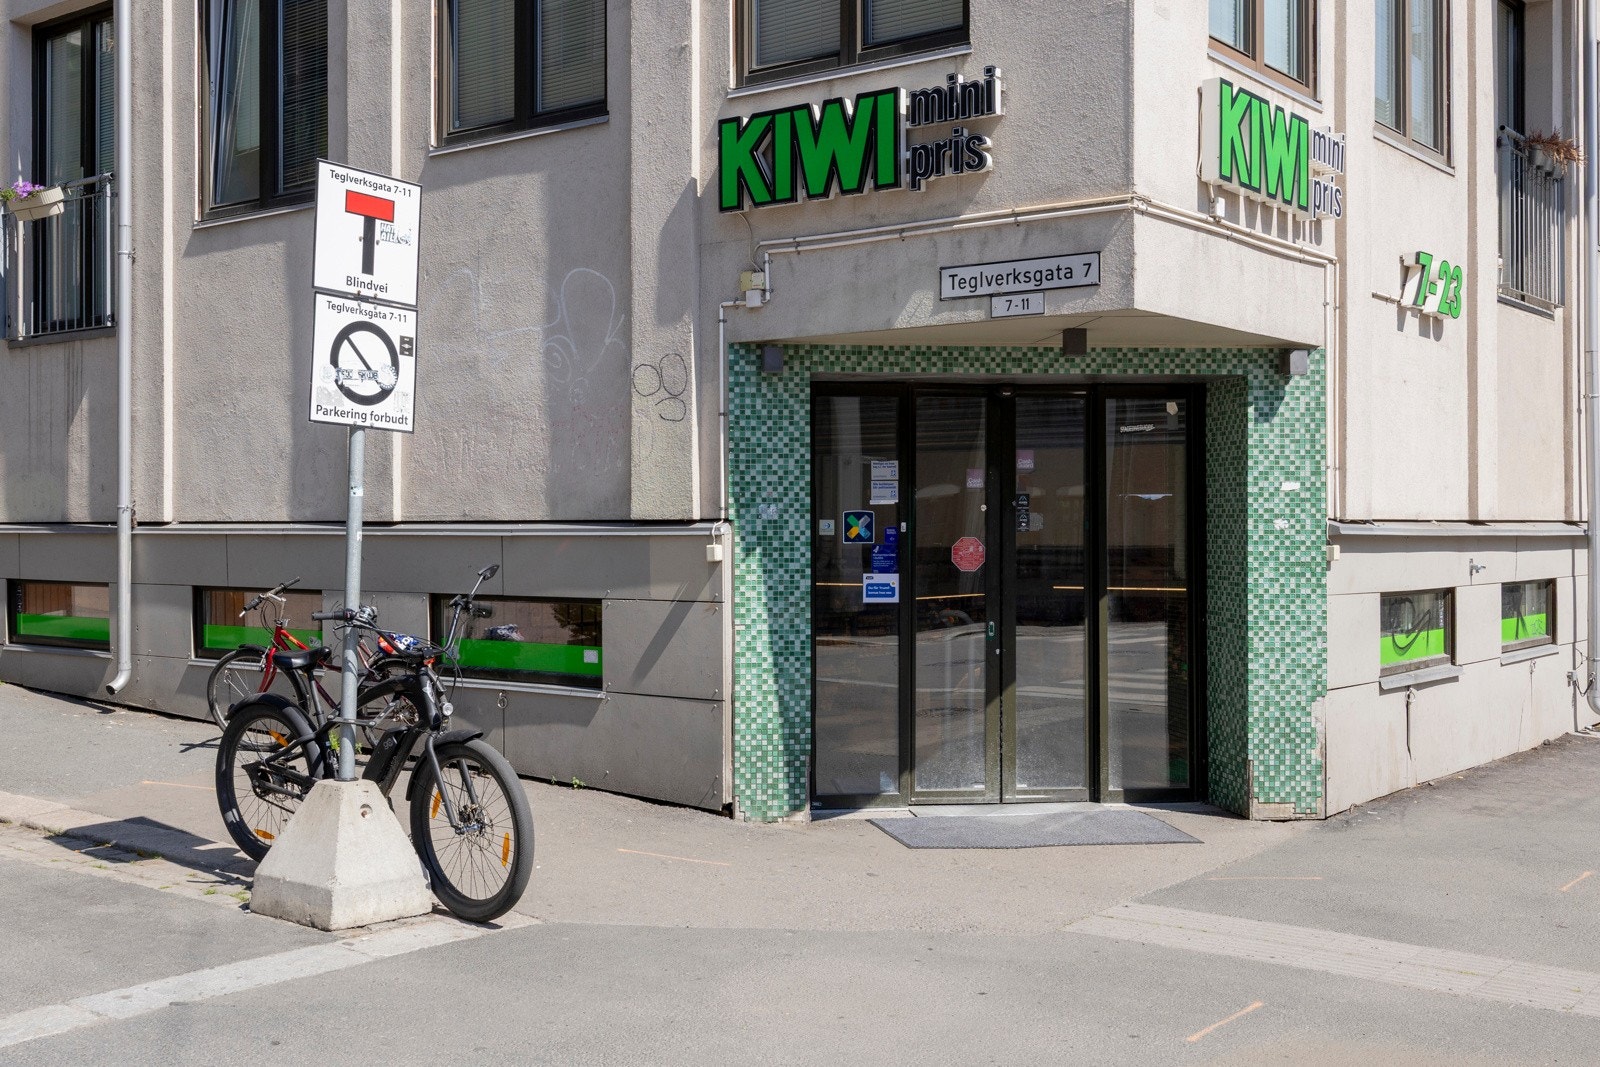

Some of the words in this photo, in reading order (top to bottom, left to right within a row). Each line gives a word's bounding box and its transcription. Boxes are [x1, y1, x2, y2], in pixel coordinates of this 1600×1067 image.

[909, 65, 999, 126] mini
[718, 87, 903, 213] KIWI
[909, 127, 991, 191] pris
[1219, 77, 1310, 213] KIWI
[1312, 127, 1345, 174] mini
[329, 169, 392, 193] Teglverksgata
[393, 186, 412, 198] 7-11
[1313, 176, 1342, 219] pris
[346, 276, 388, 293] Blindvei
[948, 264, 1073, 293] Teglverksgata
[1082, 262, 1092, 278] 7
[1413, 251, 1463, 319] 7-23
[326, 301, 387, 320] Teglverksgata
[389, 312, 407, 323] 7-11
[1005, 298, 1030, 312] 7-11
[316, 405, 367, 423] Parkering
[369, 411, 409, 426] forbudt
